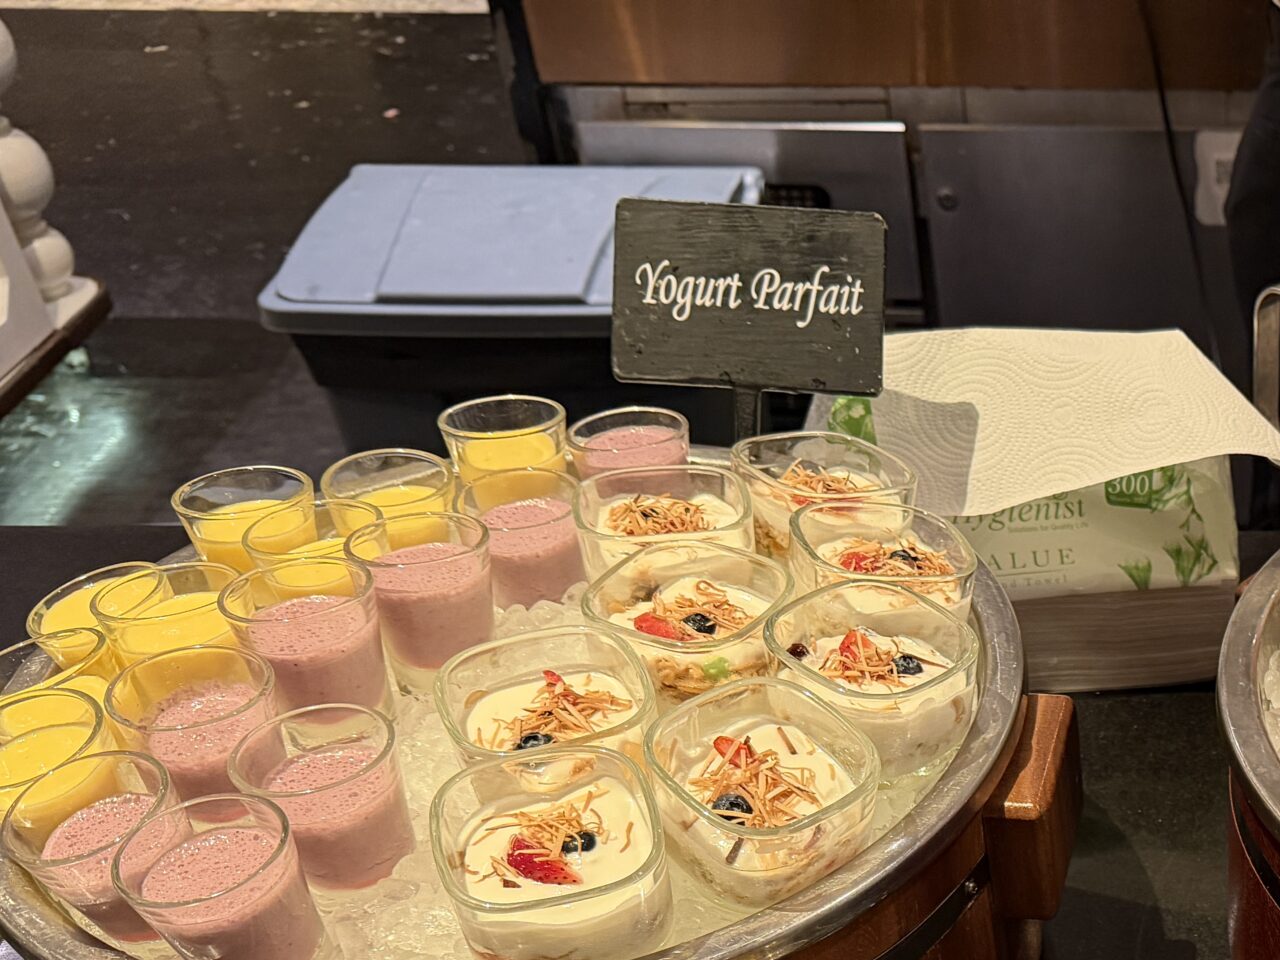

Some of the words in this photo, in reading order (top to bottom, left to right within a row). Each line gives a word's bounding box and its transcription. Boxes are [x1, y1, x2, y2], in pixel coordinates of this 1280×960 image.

[635, 259, 743, 322] Yogurt
[751, 265, 865, 328] Parfait
[1107, 475, 1150, 495] 300
[951, 498, 1087, 532] ygienist
[988, 548, 1077, 571] ALUE
